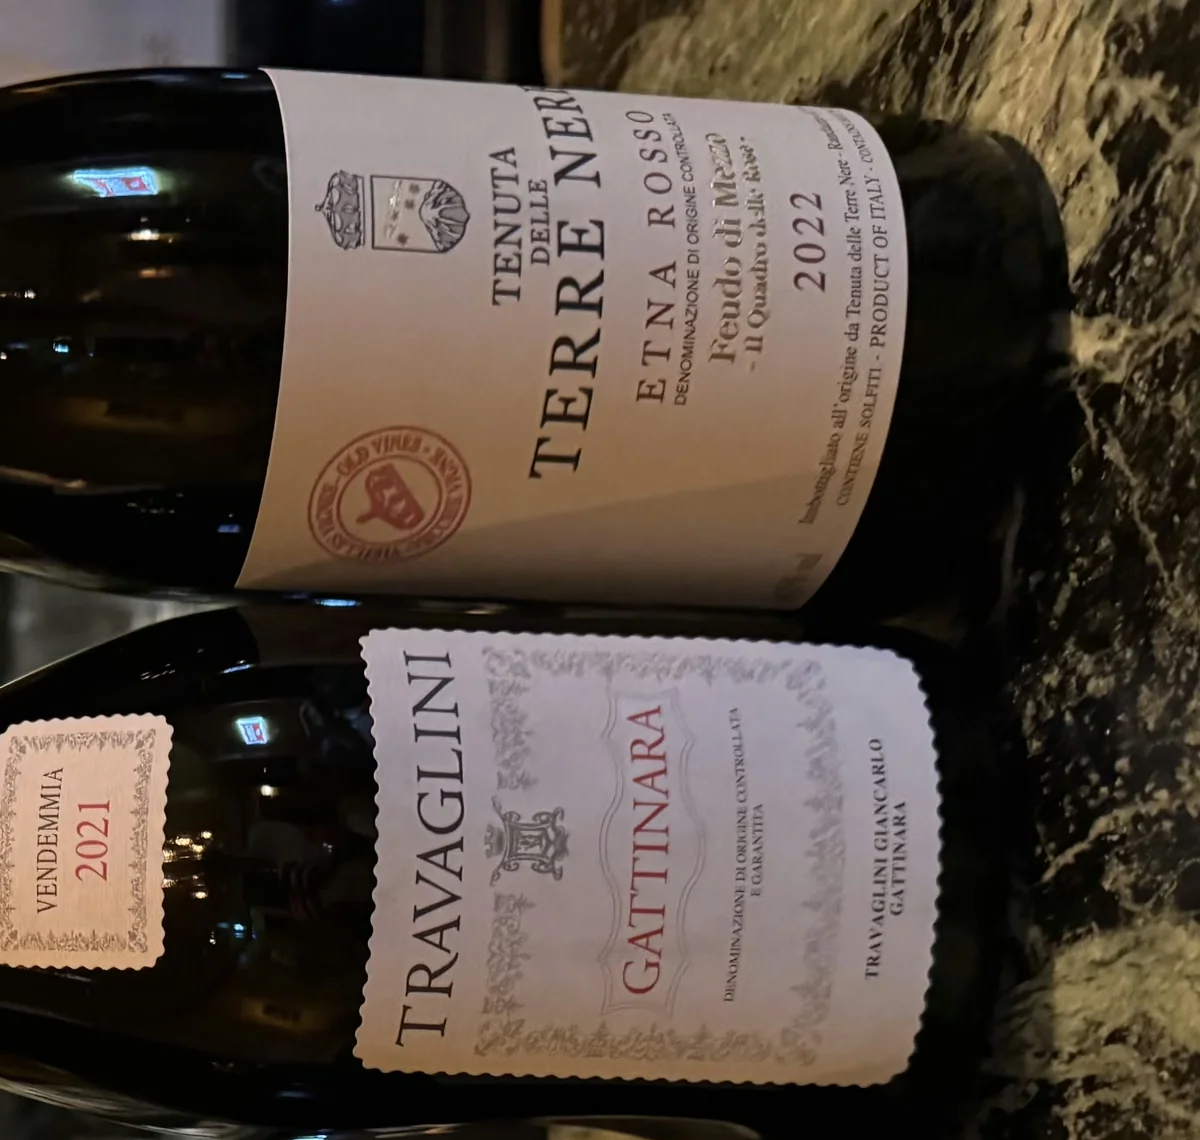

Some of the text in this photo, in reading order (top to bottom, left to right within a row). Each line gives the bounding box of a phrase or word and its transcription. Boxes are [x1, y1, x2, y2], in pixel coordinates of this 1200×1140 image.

[745, 189, 768, 238] delle
[837, 159, 855, 186] Nere
[844, 190, 861, 224] Terre
[863, 173, 887, 220] ITALY
[488, 147, 522, 307] TENUTA
[528, 179, 550, 266] DELLE
[625, 109, 677, 404] ETNA ROSSO
[662, 112, 699, 406] DENOMINAZIONE DI ORIGINE CONTROLLATA
[705, 132, 744, 365] Feudo di Mezzo
[789, 192, 826, 293] 2022
[846, 227, 862, 262] delle
[871, 224, 889, 249] OF
[746, 241, 770, 329] Quadro
[845, 266, 862, 318] Tenuta
[869, 254, 889, 348] PRODUCT
[529, 218, 605, 478] TERRE
[844, 323, 860, 342] da
[831, 346, 858, 429] all'origine
[858, 368, 882, 428] SOLFITI
[836, 431, 869, 506] CONTIENE
[36, 766, 64, 914] VENDEMMIA
[75, 800, 111, 882] 2021
[394, 650, 466, 1048] TRAVAGLINI
[621, 705, 670, 996] GATTINARA
[723, 707, 747, 1003] DENOMINAZIONE DI ORIGINE CONTROLLATA
[751, 803, 764, 897] E GARANTITA
[864, 738, 889, 980] TRAVAGLINI GIANCARLO
[890, 801, 907, 916] GATTINARA
